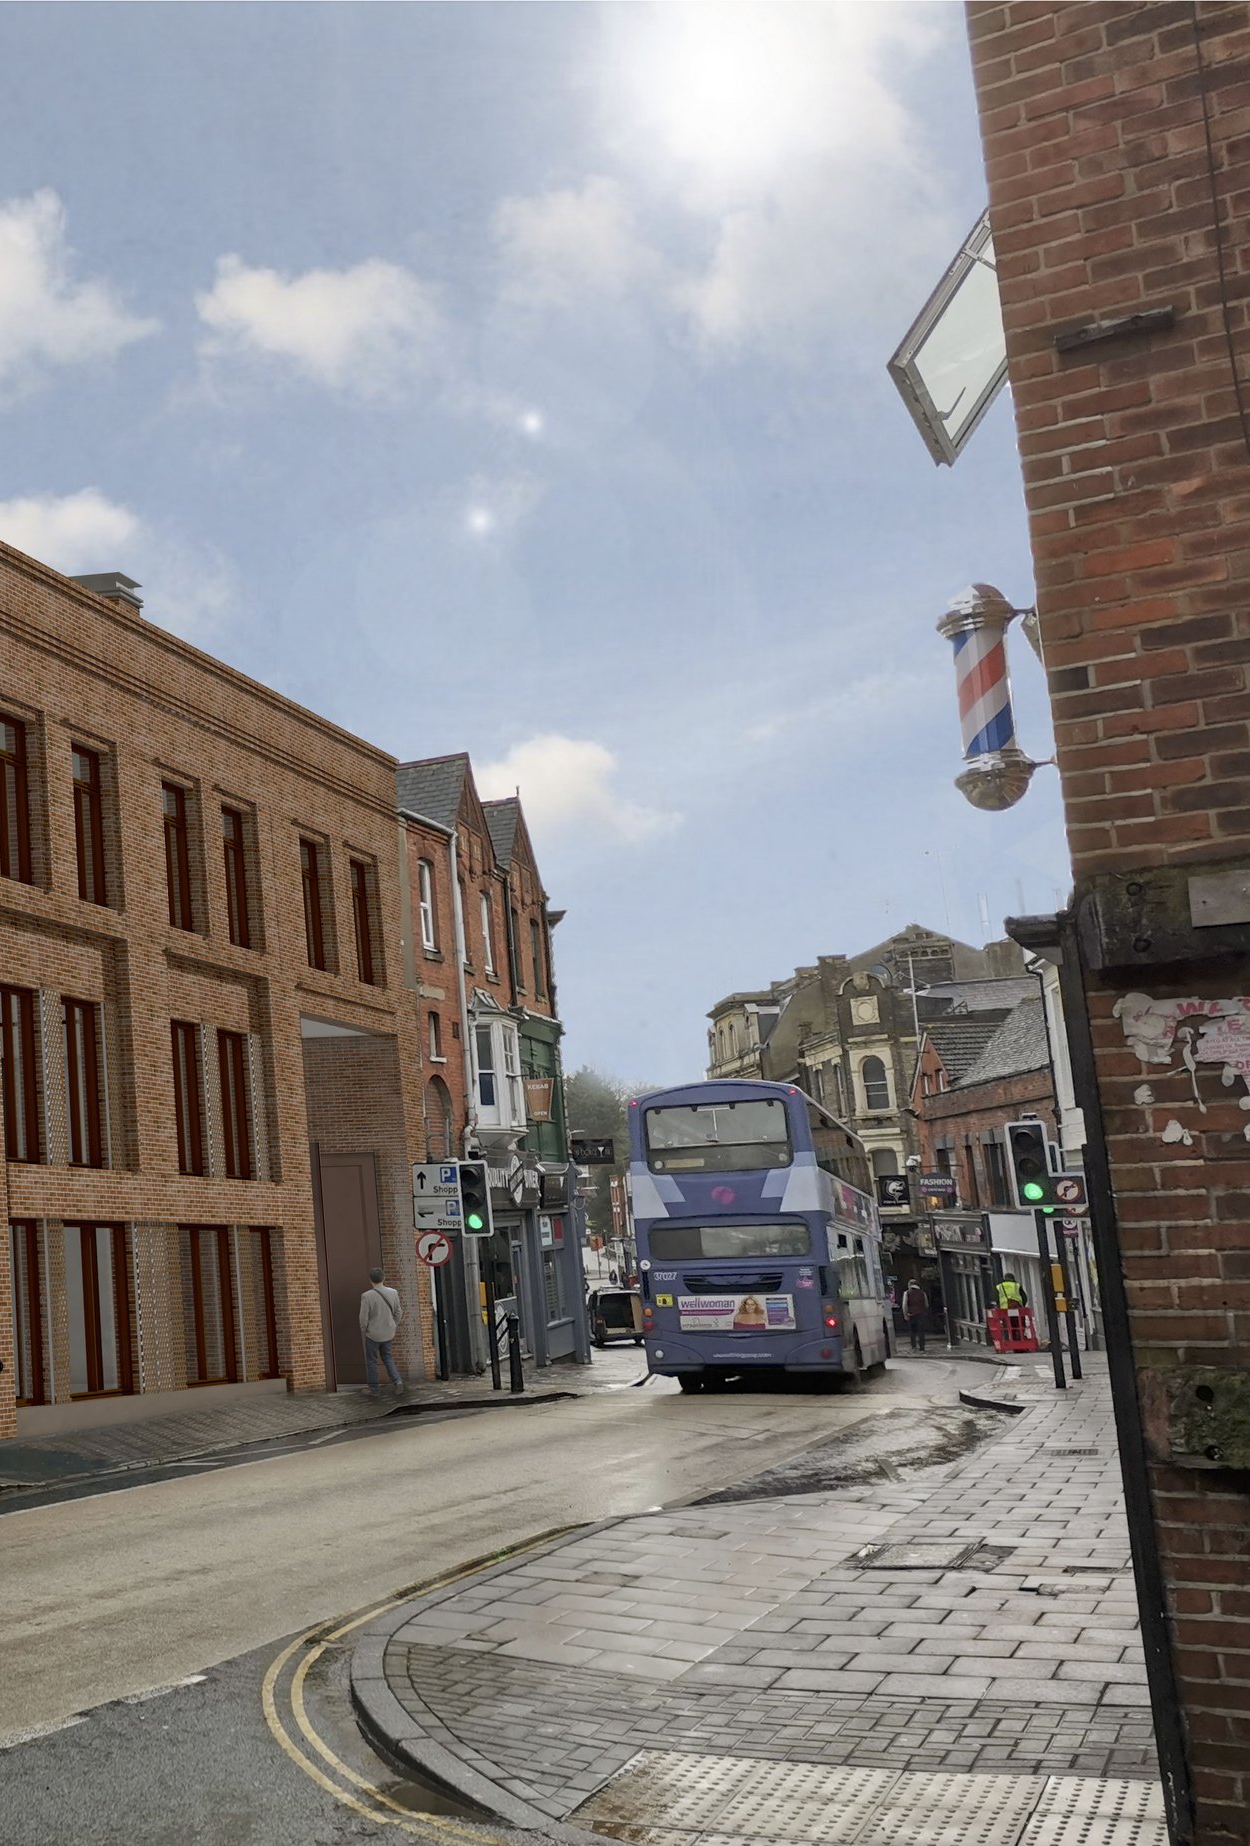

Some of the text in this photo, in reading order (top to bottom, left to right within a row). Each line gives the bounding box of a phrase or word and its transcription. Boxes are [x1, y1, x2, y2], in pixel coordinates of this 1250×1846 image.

[441, 1167, 451, 1182] P
[920, 1178, 952, 1186] FASHION
[446, 1200, 457, 1215] P
[653, 1271, 677, 1281] 37027
[680, 1297, 735, 1309] wellwoman
